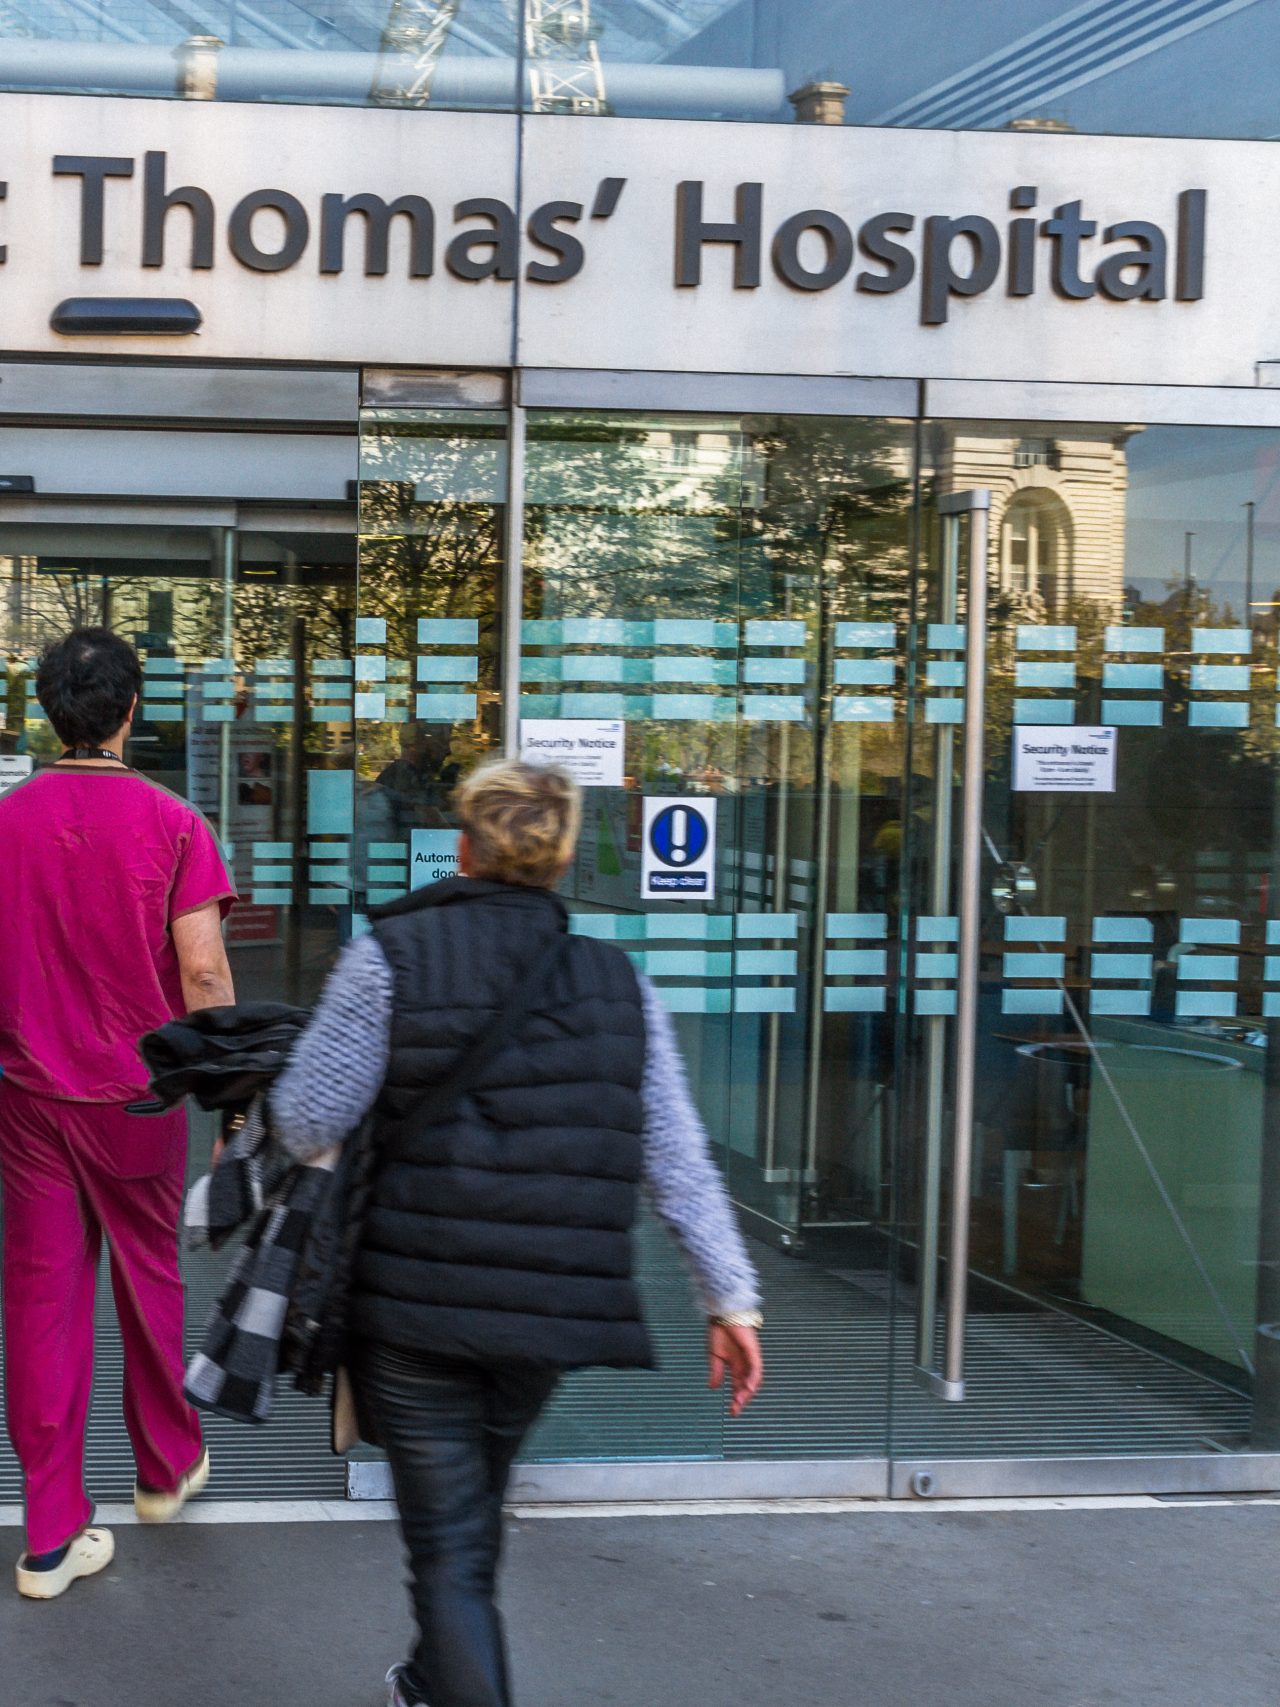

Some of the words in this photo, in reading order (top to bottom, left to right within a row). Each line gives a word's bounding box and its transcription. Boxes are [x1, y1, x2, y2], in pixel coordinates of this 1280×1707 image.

[52, 150, 627, 284] Thomas'
[675, 180, 1207, 326] Hospital
[527, 737, 575, 750] Security
[578, 738, 617, 749] Notice
[1022, 744, 1068, 757] Security
[1070, 744, 1109, 755] Notice
[415, 852, 462, 863] Automa
[432, 868, 459, 879] doo
[650, 875, 679, 888] Keep
[679, 875, 706, 886] clear
